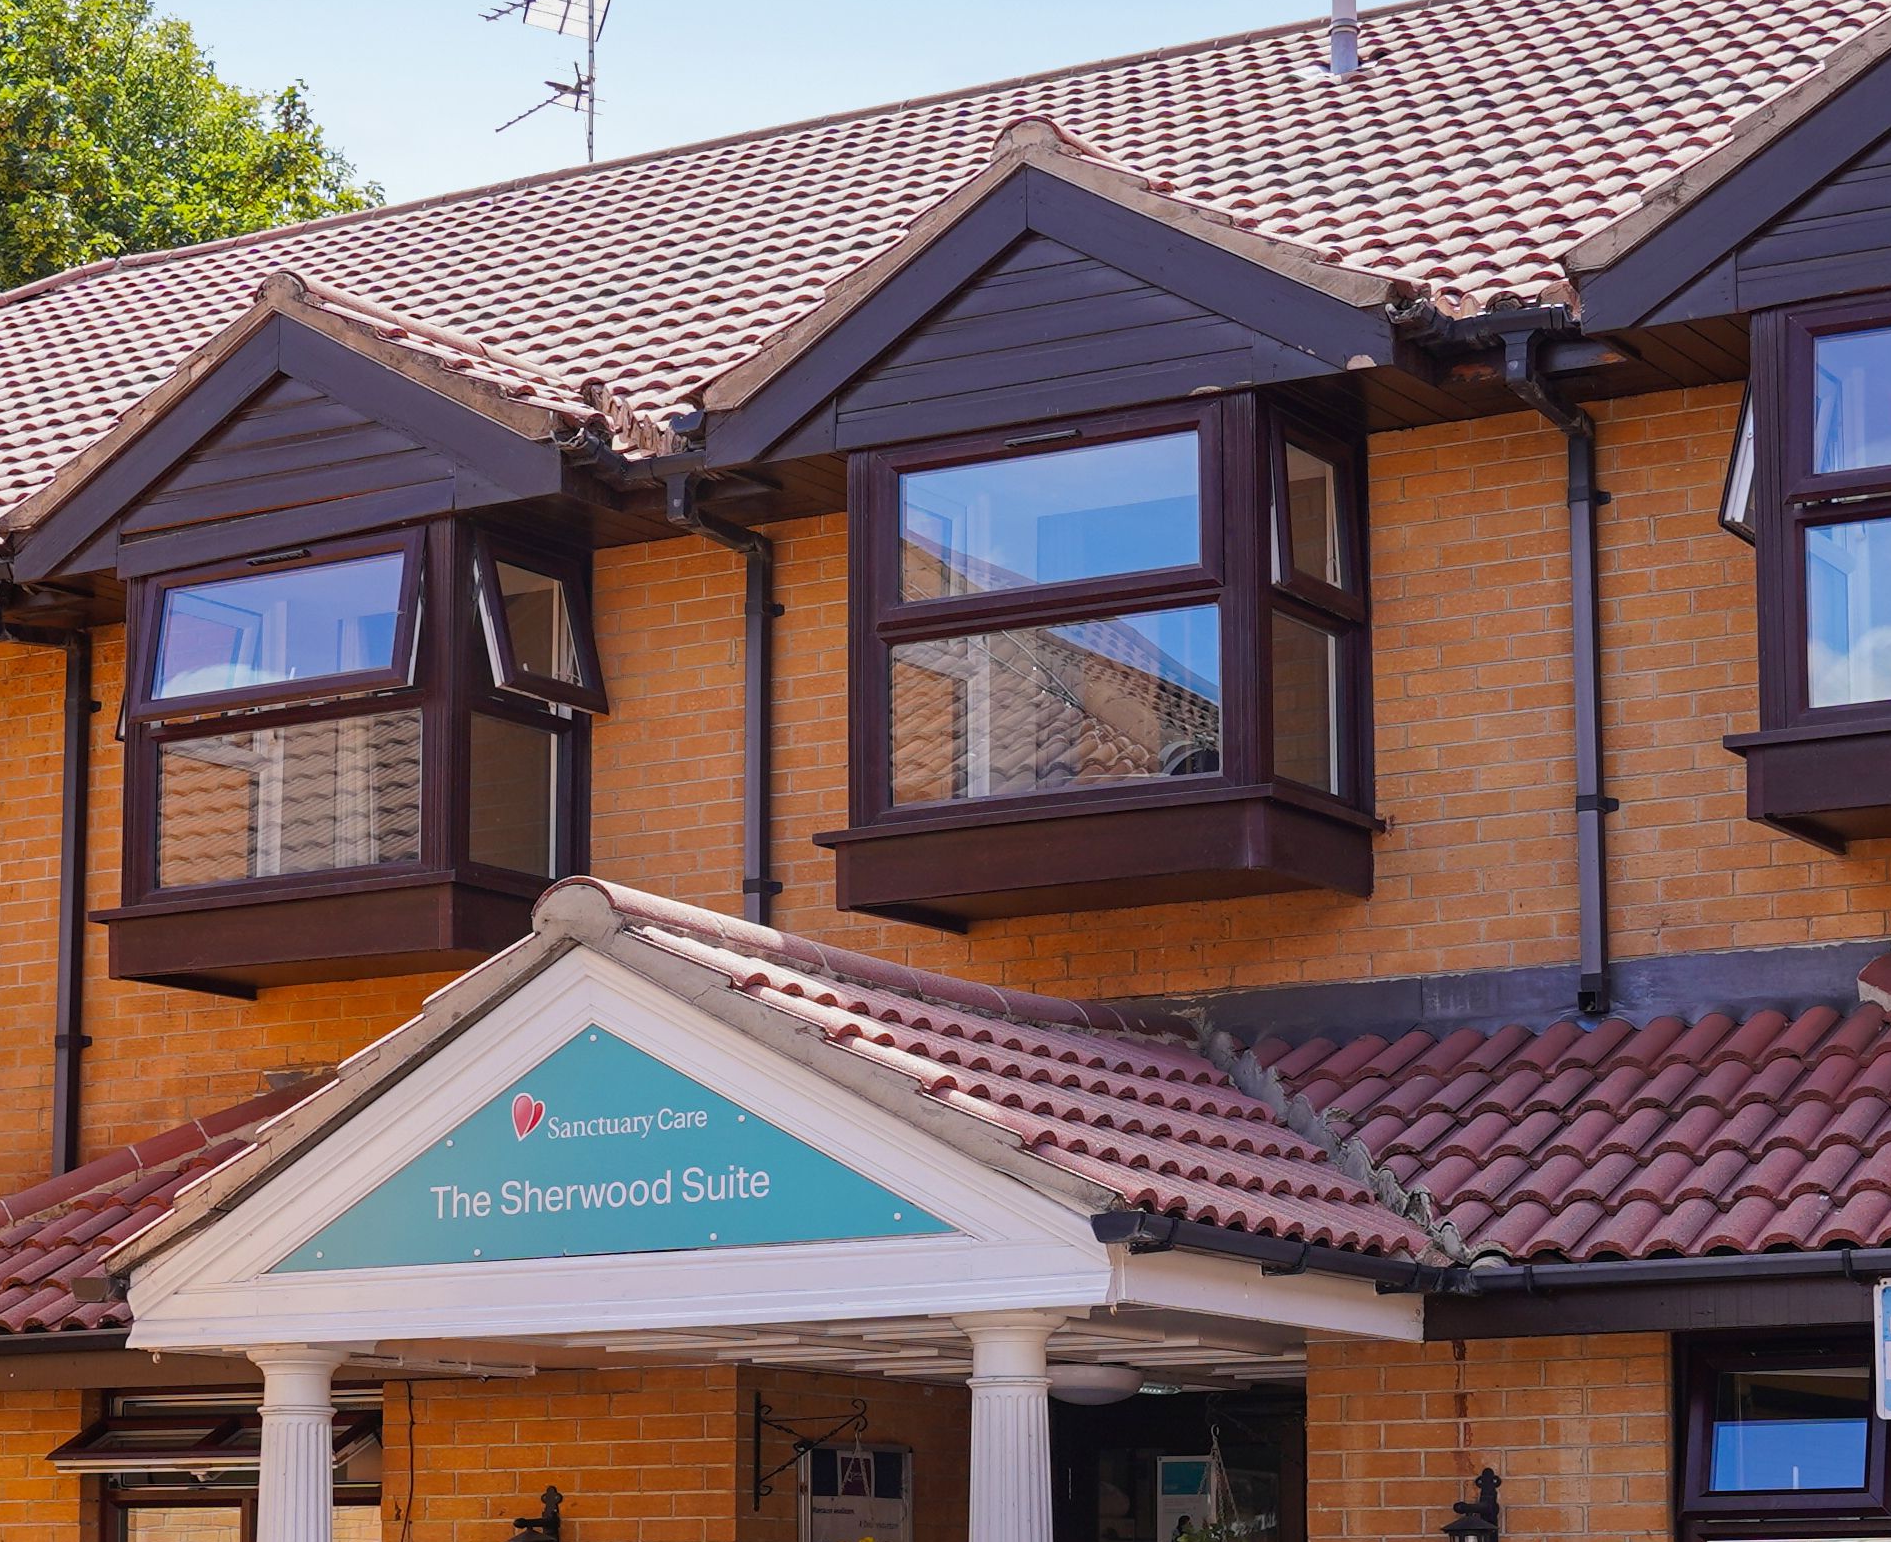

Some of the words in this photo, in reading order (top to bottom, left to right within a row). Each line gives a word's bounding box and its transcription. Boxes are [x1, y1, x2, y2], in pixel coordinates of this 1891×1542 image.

[547, 1114, 653, 1140] Sanctuary
[658, 1108, 708, 1131] Care
[430, 1185, 491, 1219] The
[500, 1169, 672, 1216] Sherwood
[682, 1164, 771, 1203] Suite
